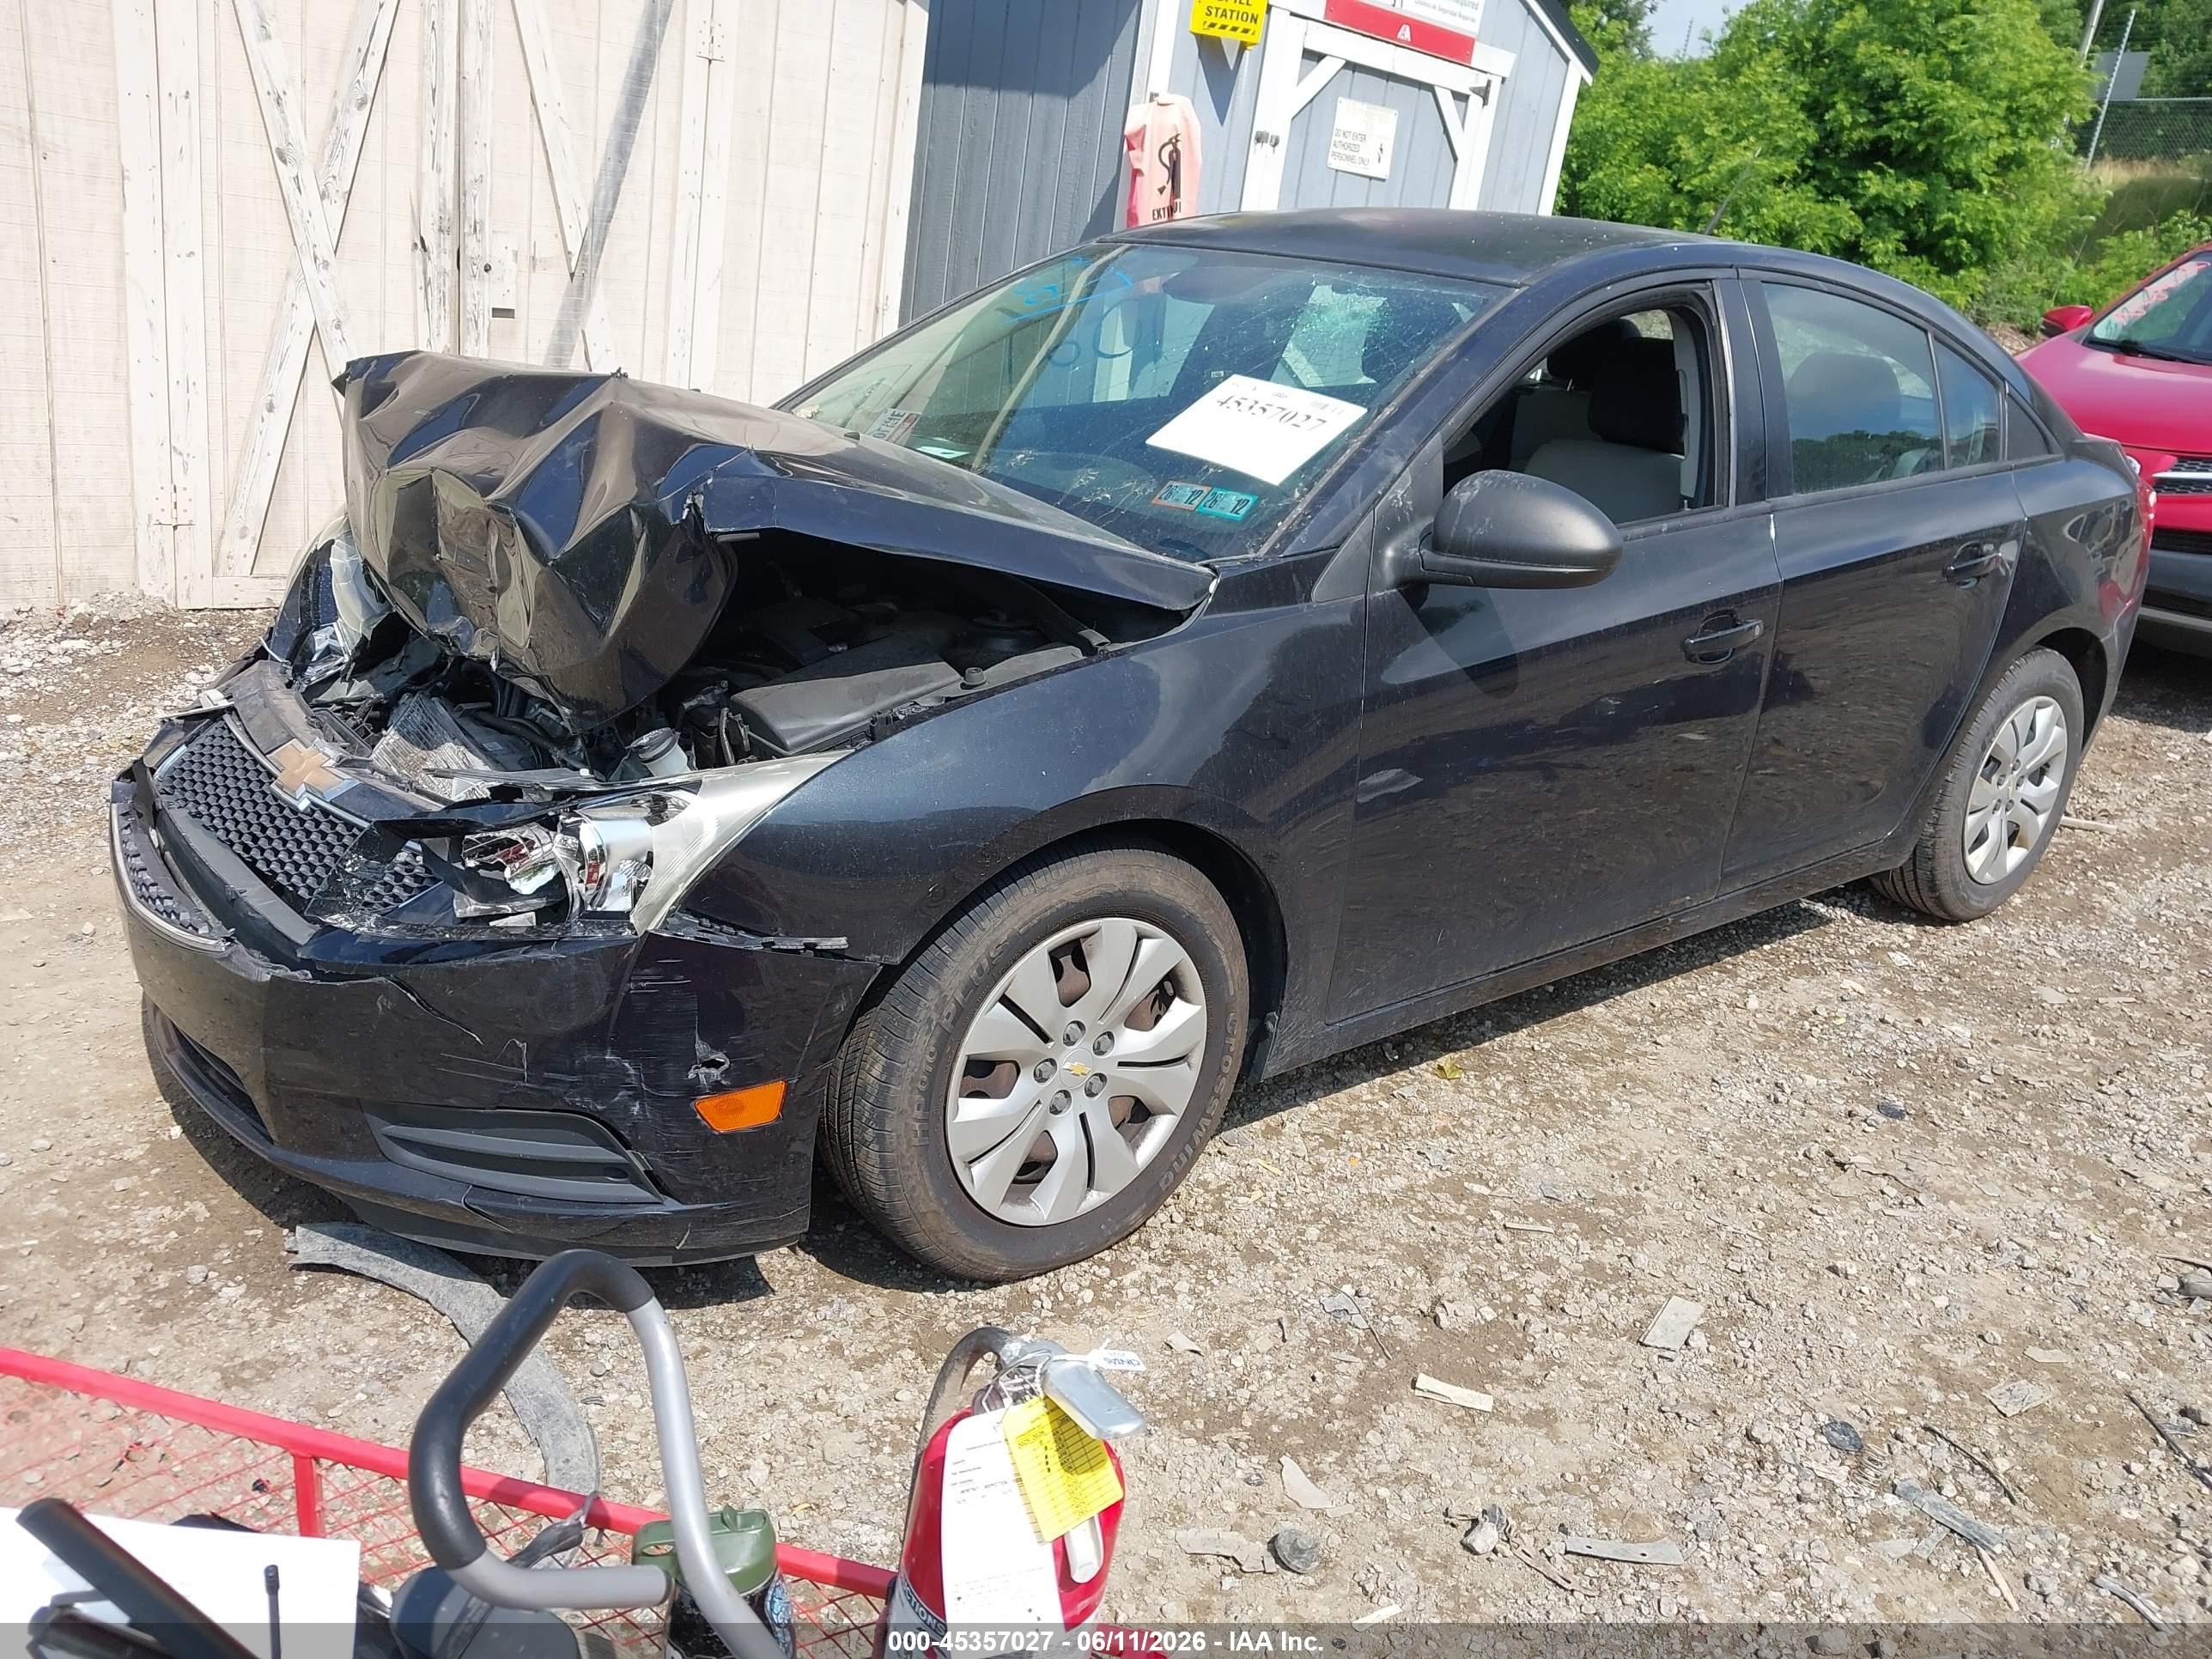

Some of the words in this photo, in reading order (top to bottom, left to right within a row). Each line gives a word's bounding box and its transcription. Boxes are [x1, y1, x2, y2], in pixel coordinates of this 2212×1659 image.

[1205, 6, 1259, 25] STATION
[1342, 130, 1352, 140] NOT
[1352, 131, 1367, 143] ENTER
[1217, 395, 1327, 431] 45357027
[1184, 489, 1204, 506] 12
[1230, 498, 1250, 515] 12
